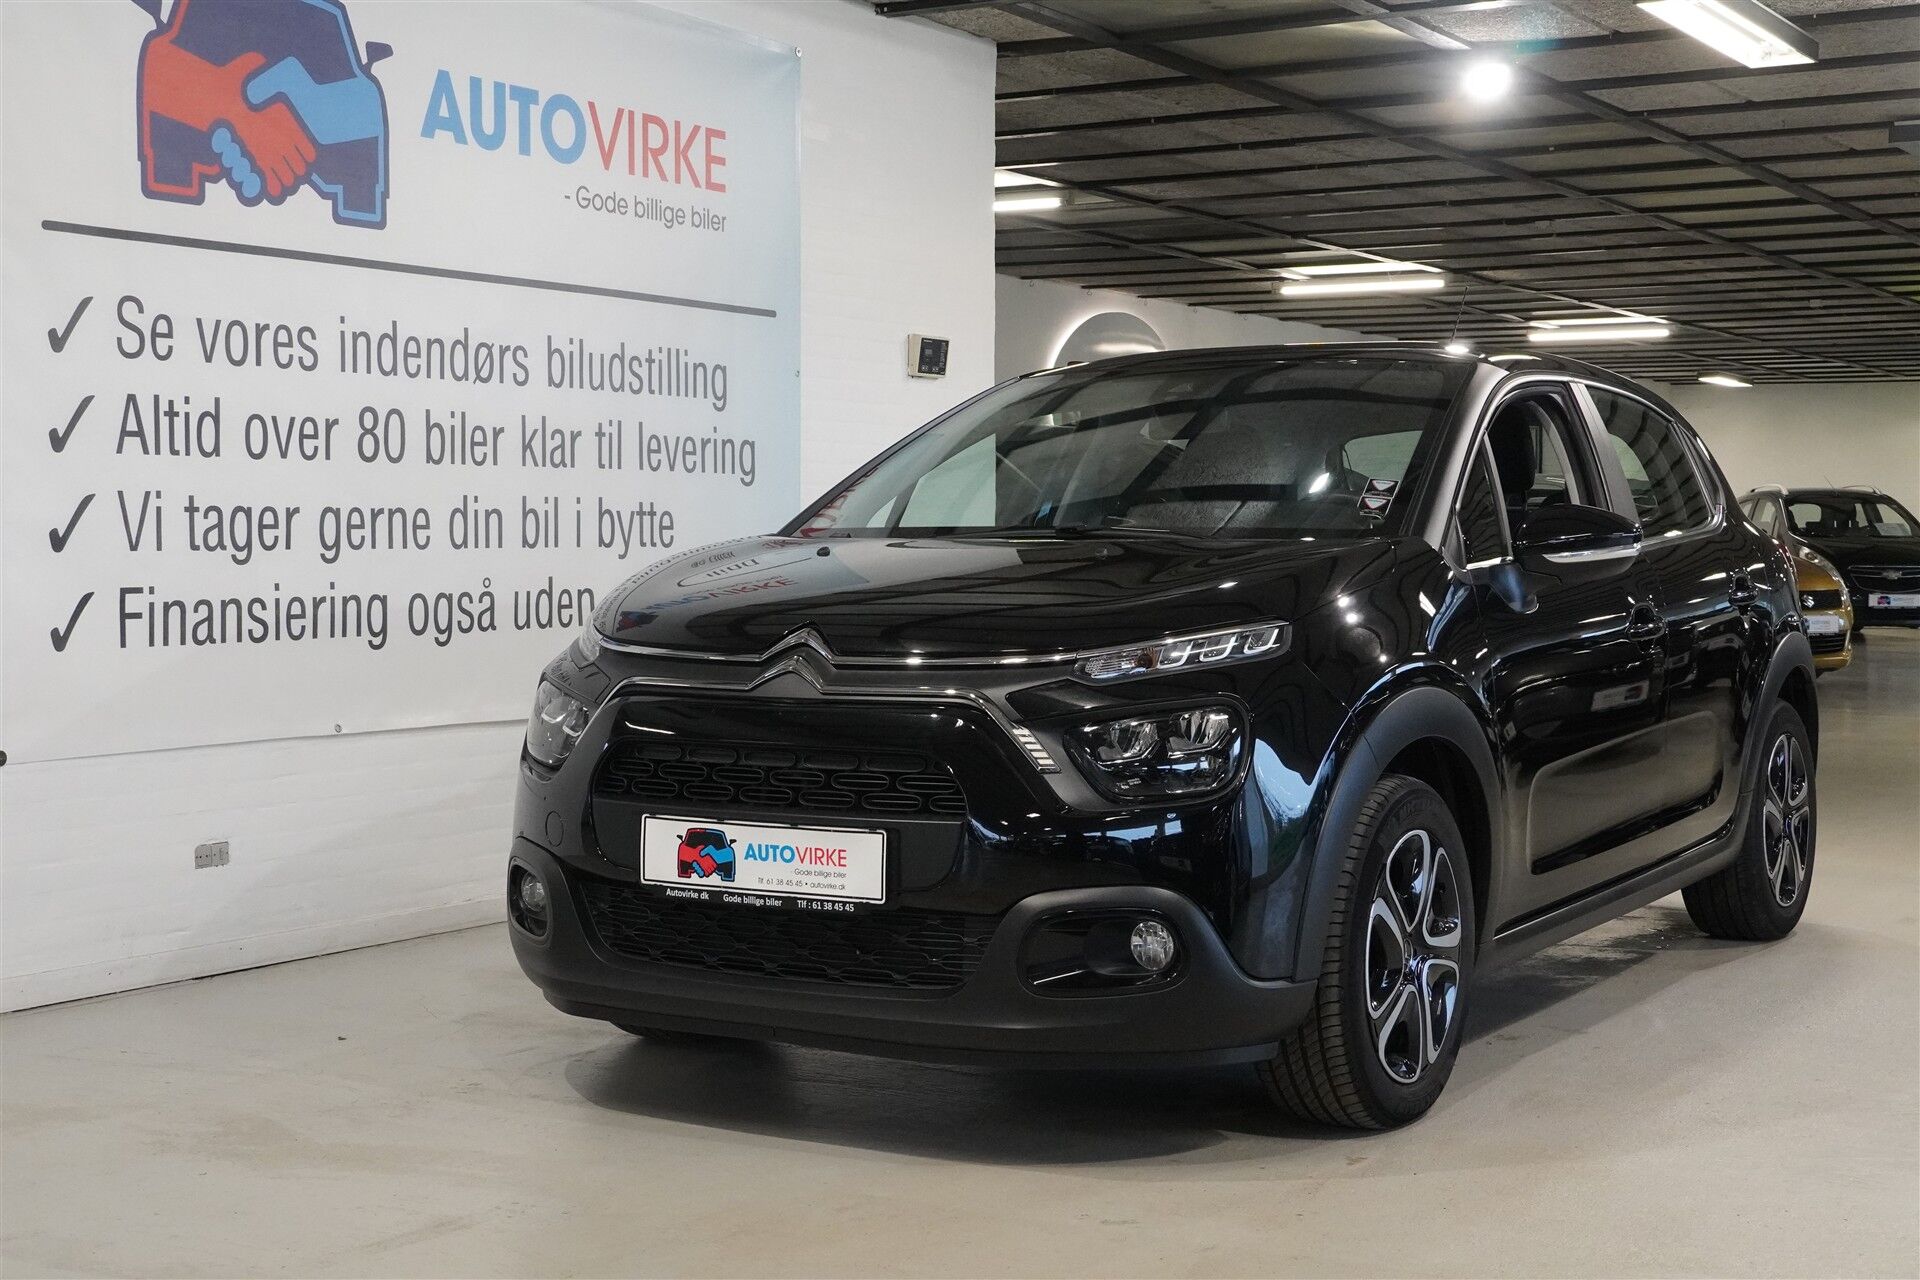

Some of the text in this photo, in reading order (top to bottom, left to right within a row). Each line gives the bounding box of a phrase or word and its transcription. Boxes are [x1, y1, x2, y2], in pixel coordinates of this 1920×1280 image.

[421, 69, 727, 193] AUTOVIRKE
[576, 185, 628, 215] Gode
[634, 195, 686, 230] billige
[691, 205, 728, 232] biler
[116, 294, 729, 413] Se vores indendørs biludstilling
[115, 392, 757, 488] Altid over 80 biler klar til levering
[116, 489, 676, 566] Vi tager gerne din bil i bytte
[118, 583, 388, 651] Finansiering
[407, 577, 497, 648] også
[513, 573, 595, 632] uden
[743, 842, 848, 868] AUTOVIRKE
[794, 868, 813, 877] Gode
[723, 893, 742, 904] Gode
[743, 895, 764, 907] billige
[765, 897, 783, 907] biler
[812, 901, 821, 910] 61
[823, 902, 833, 910] 38
[833, 902, 844, 911] 45
[844, 903, 855, 912] 45
